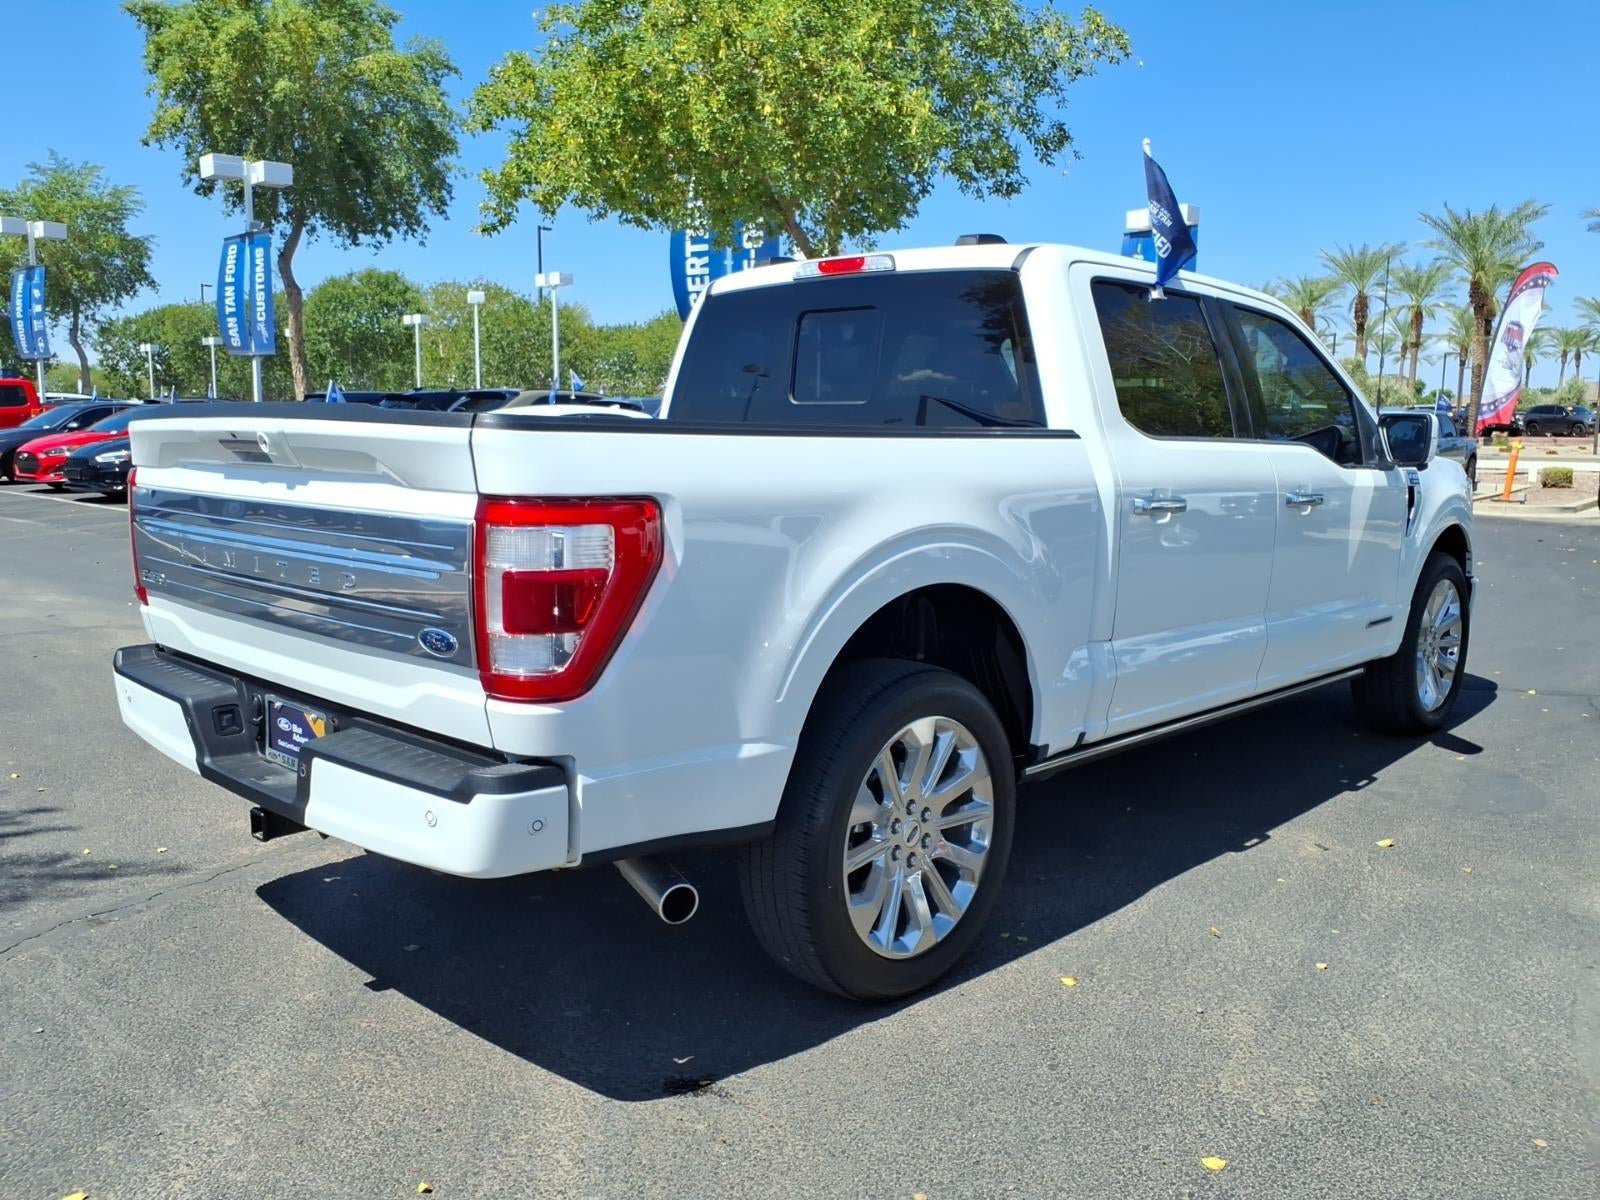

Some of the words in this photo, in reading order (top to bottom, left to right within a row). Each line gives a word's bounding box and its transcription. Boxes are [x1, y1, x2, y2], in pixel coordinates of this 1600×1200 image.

[225, 244, 238, 284] FORD
[15, 273, 25, 318] PARTNER
[224, 285, 237, 315] TAN
[255, 247, 266, 322] CUSTOMS
[16, 319, 30, 354] PROUD
[226, 316, 241, 347] SAN
[180, 542, 357, 590] LIMITED
